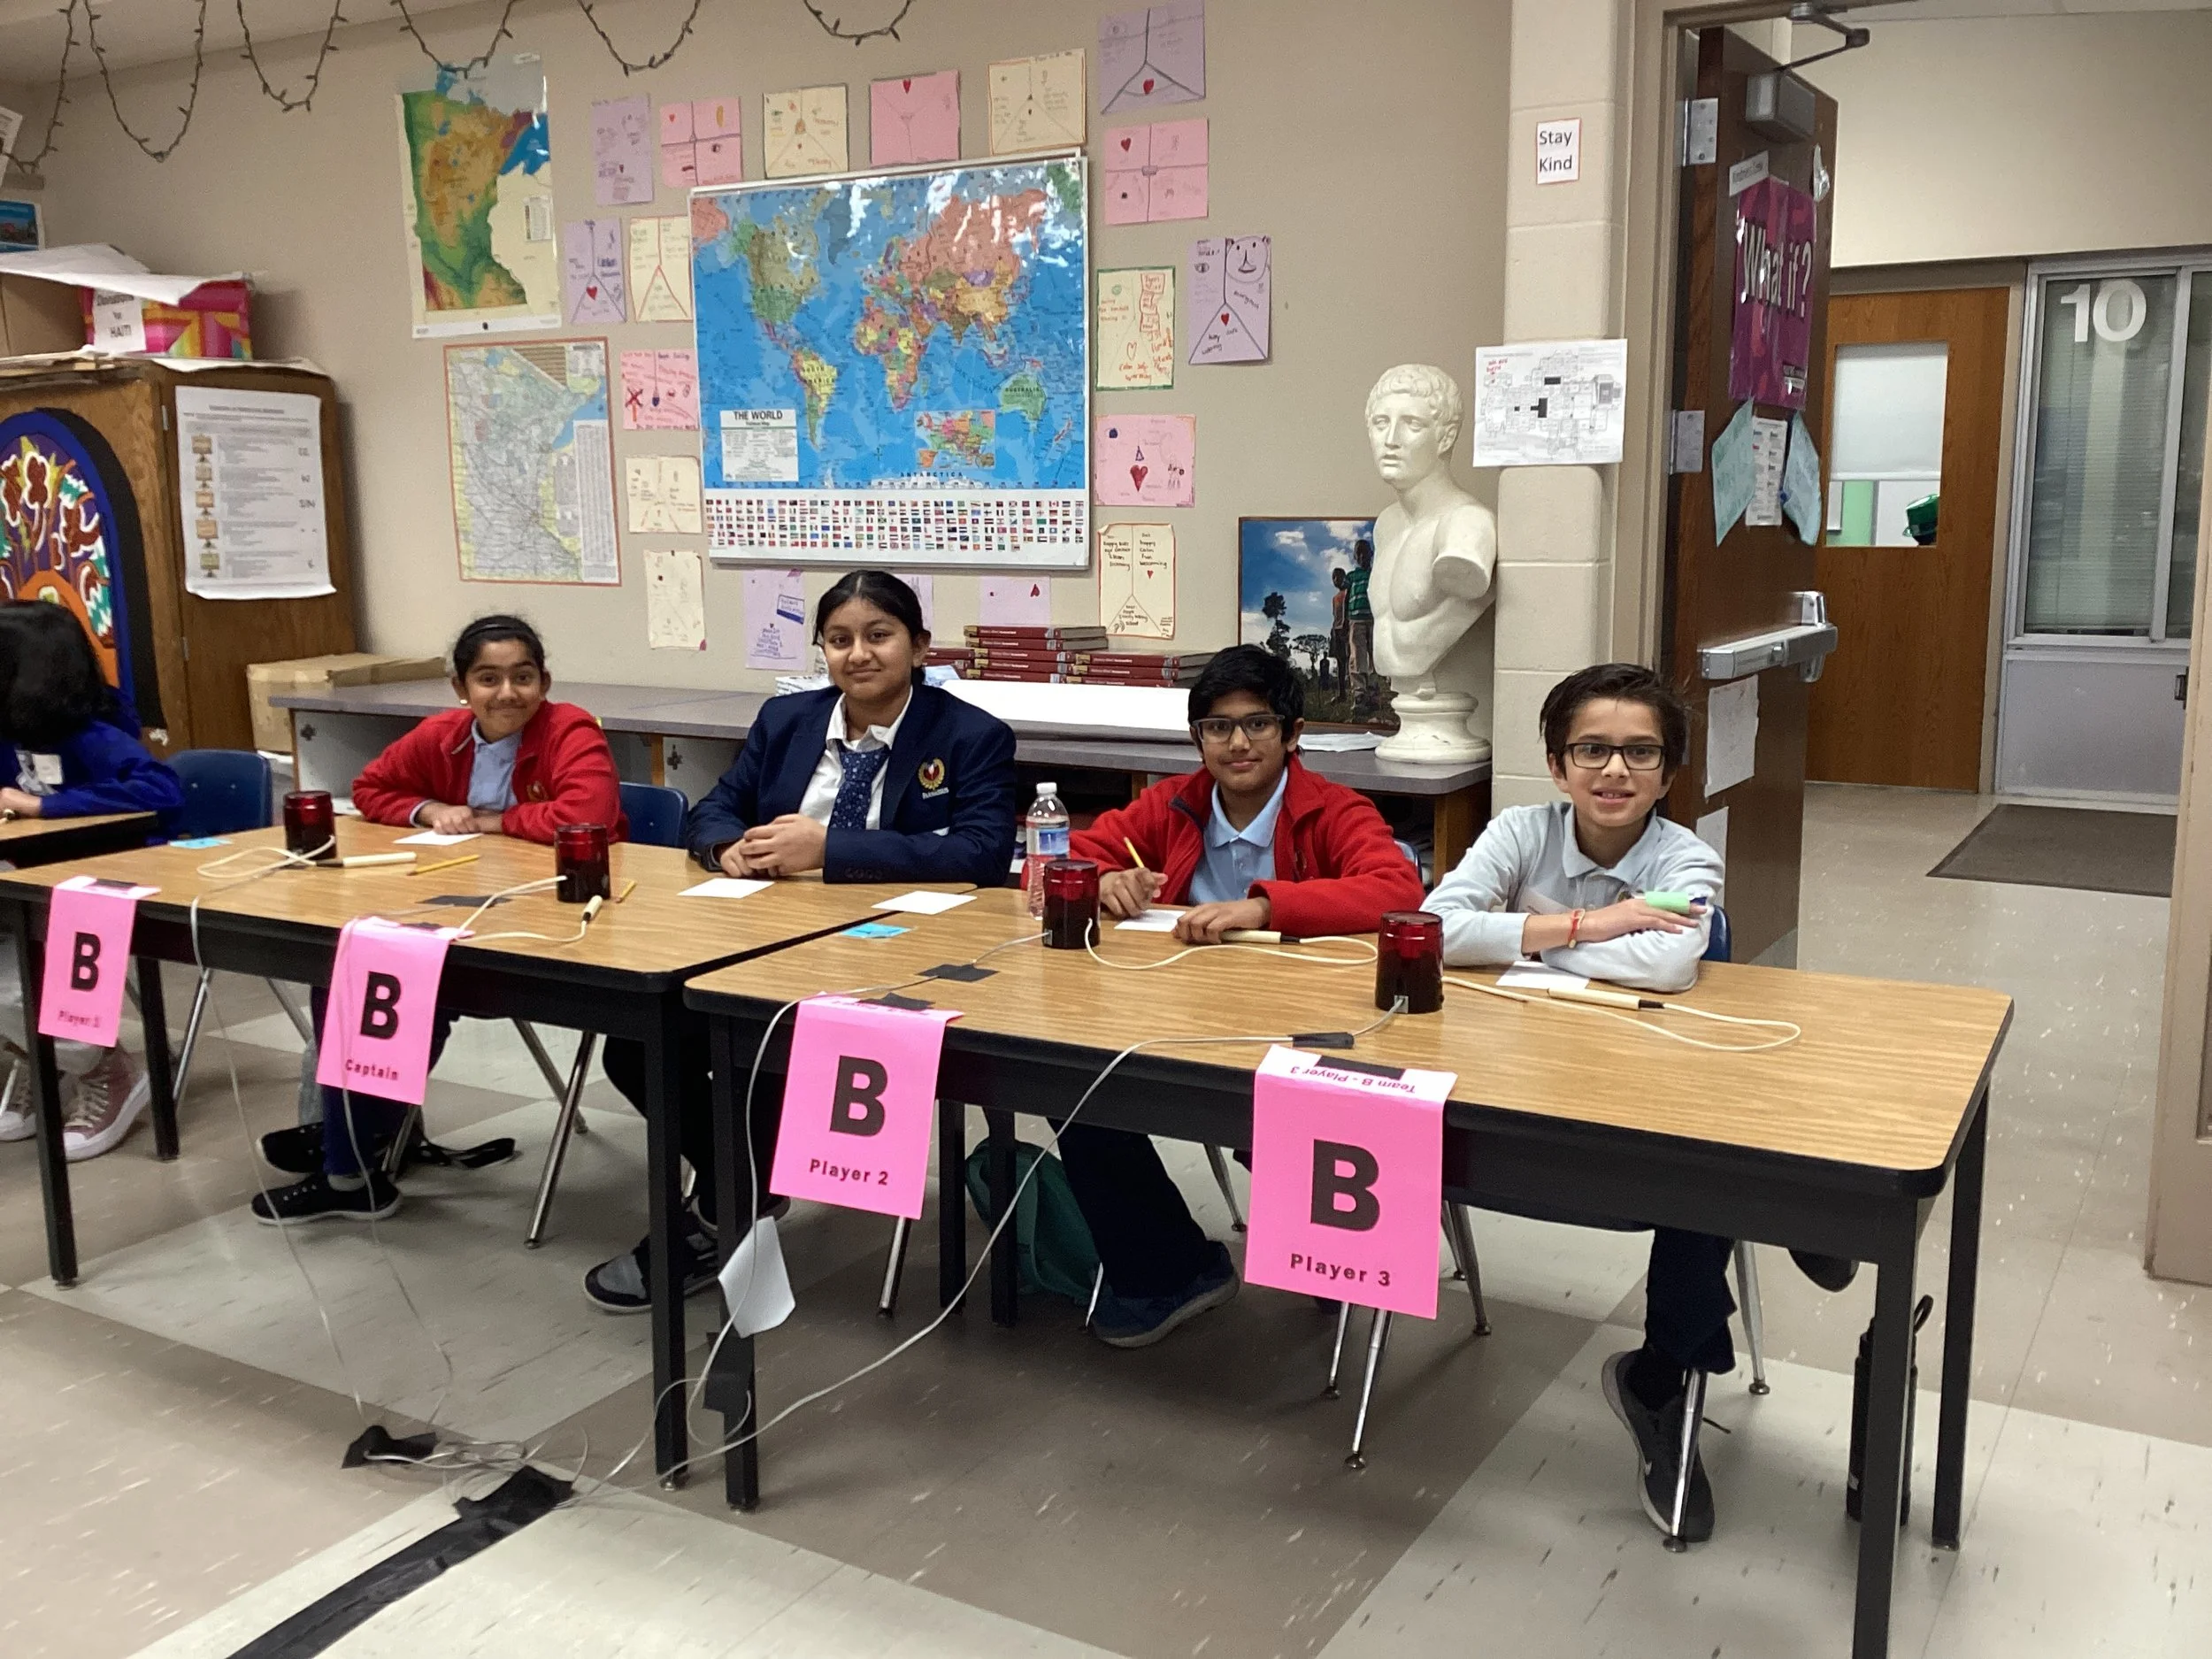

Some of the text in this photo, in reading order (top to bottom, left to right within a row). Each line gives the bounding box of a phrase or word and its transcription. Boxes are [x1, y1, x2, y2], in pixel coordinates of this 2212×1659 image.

[1540, 130, 1572, 147] Stay
[1540, 155, 1572, 173] Kind
[1744, 222, 1812, 318] What if?
[2060, 278, 2147, 342] 10
[733, 410, 783, 420] THE WORLD
[71, 932, 101, 992] B
[58, 1010, 89, 1026] Player
[360, 971, 402, 1040] B
[345, 1059, 398, 1080] Captain
[1302, 1068, 1348, 1082] Player
[829, 1055, 888, 1138] B
[1378, 1080, 1416, 1094] Team
[810, 1158, 888, 1186] Player 2
[1310, 1139, 1380, 1232] B
[1291, 1253, 1390, 1286] Player 3
